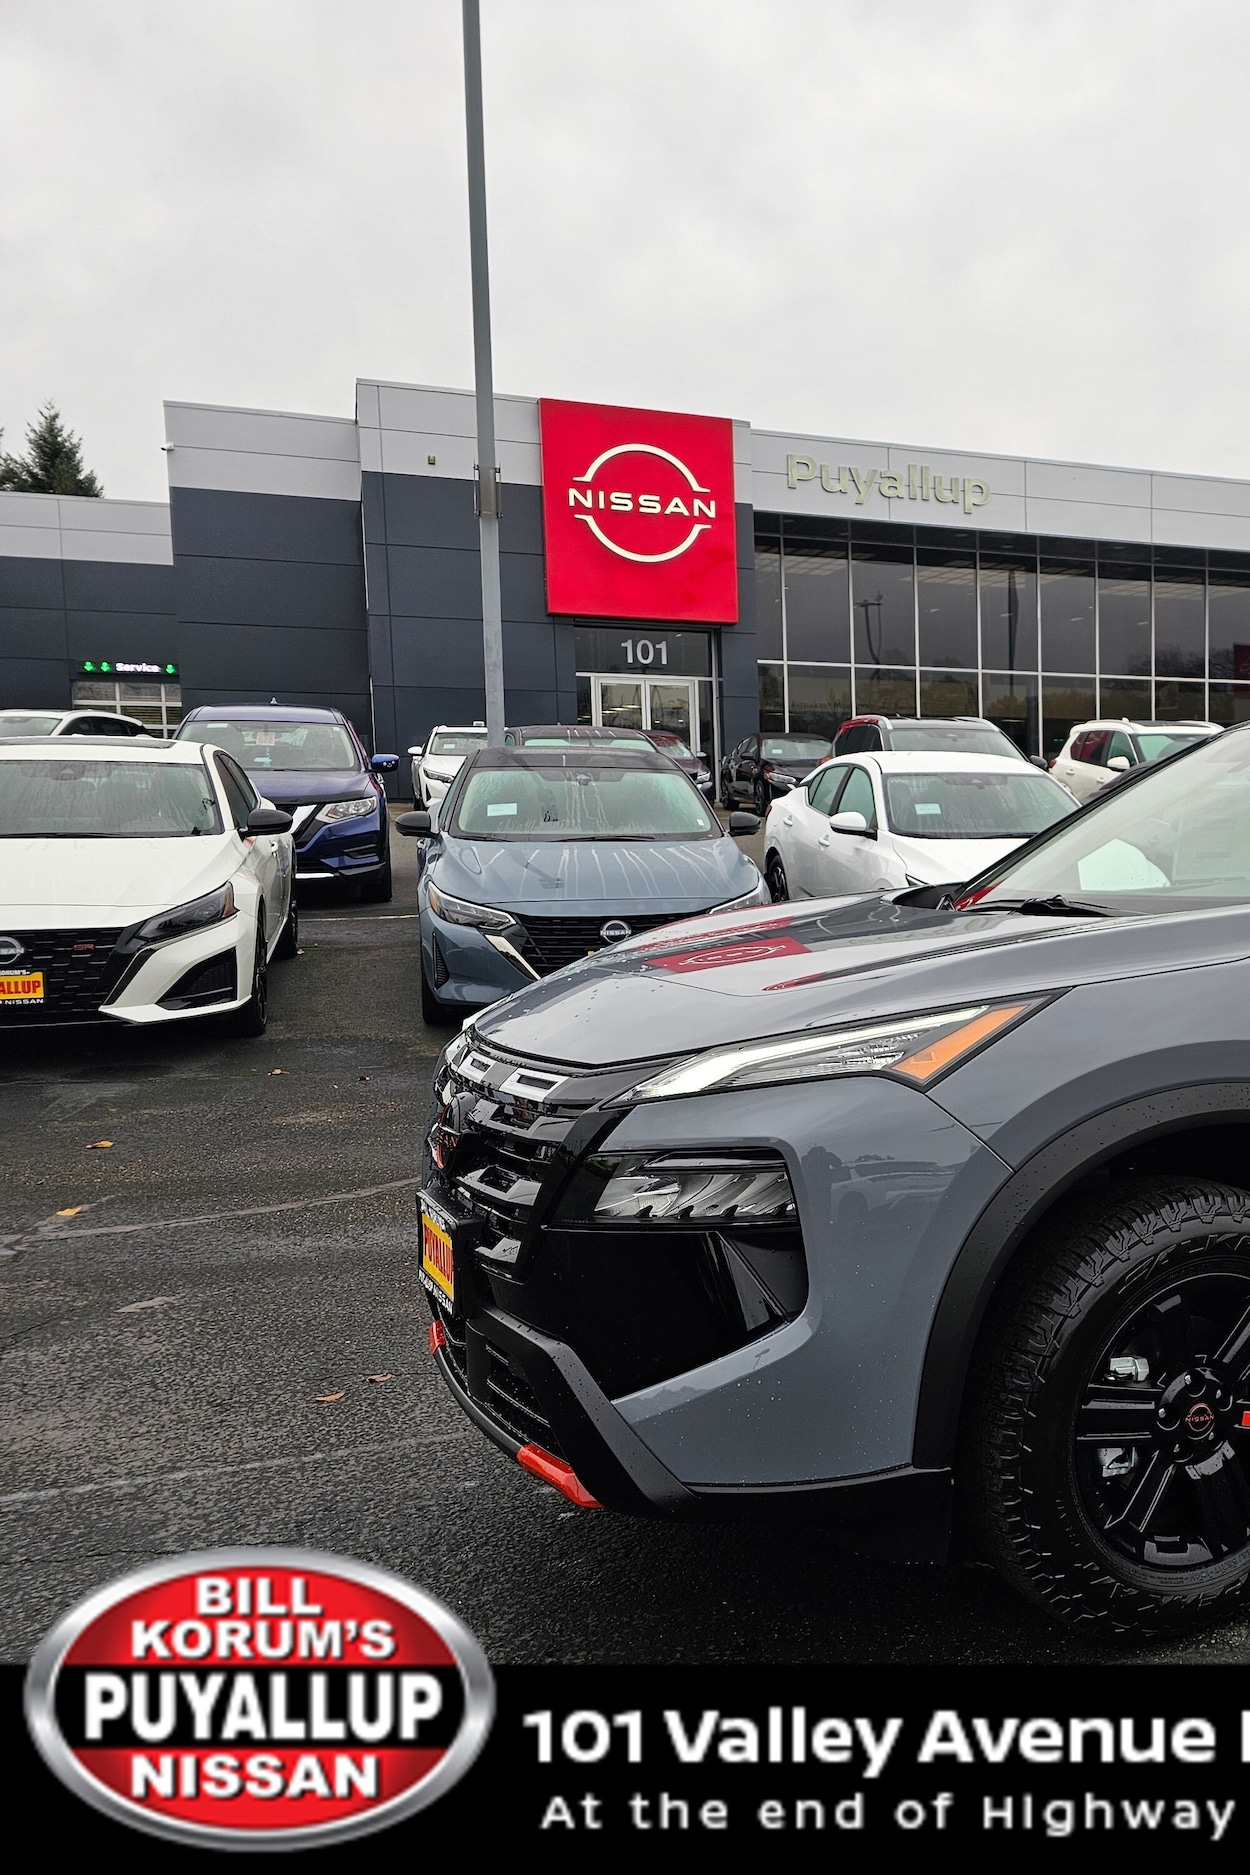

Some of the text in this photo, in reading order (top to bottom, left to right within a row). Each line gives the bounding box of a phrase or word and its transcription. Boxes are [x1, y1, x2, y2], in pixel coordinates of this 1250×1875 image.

[787, 454, 991, 514] Puyallup
[568, 487, 716, 519] NISSAN
[620, 639, 669, 665] 101
[115, 662, 161, 673] Service
[0, 947, 24, 955] SAN
[0, 980, 41, 995] ALLUP
[1185, 1414, 1215, 1423] NISSAN
